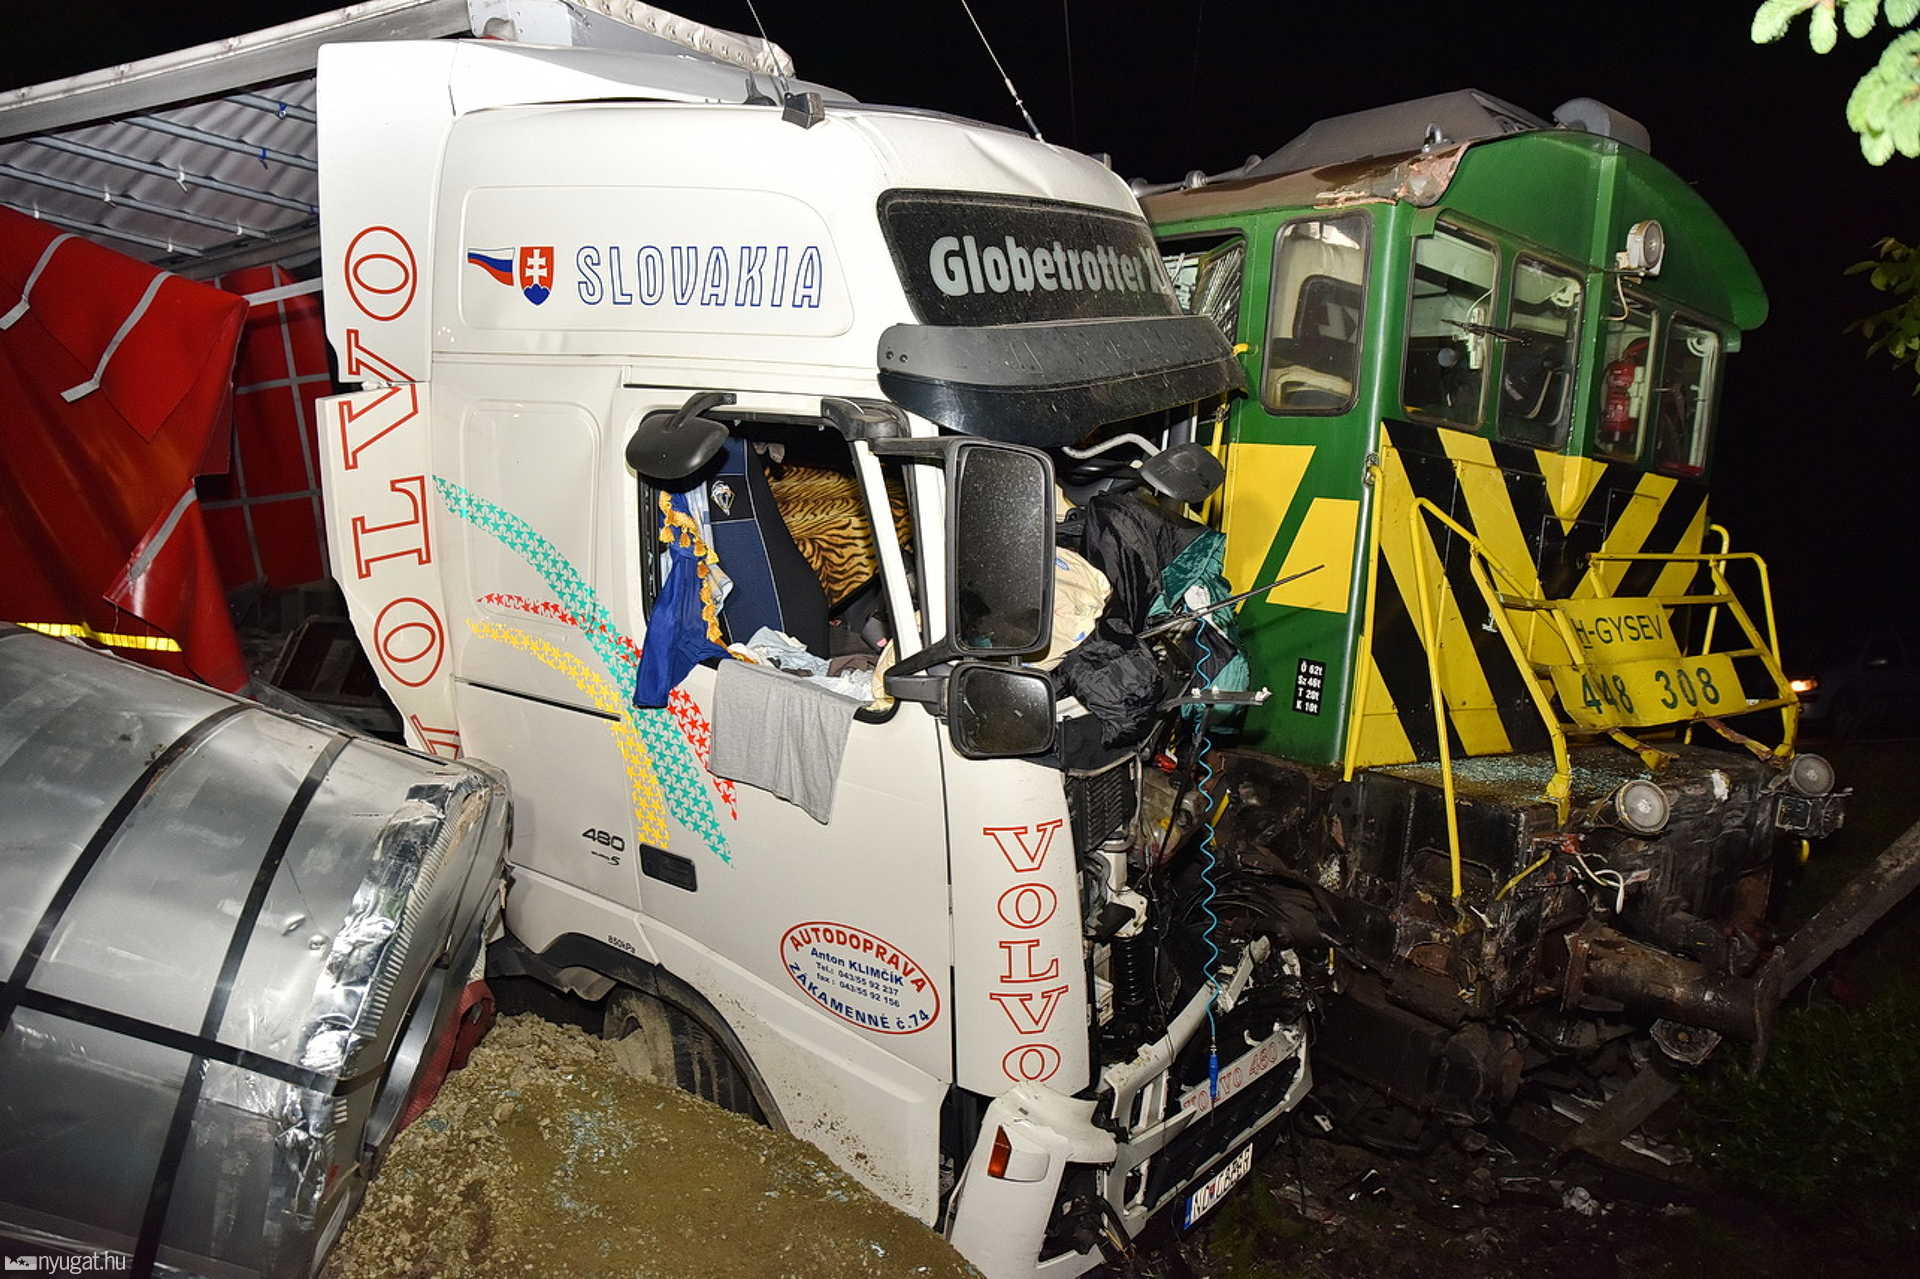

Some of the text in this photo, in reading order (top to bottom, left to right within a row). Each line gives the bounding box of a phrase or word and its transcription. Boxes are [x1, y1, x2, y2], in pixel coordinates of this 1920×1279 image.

[576, 245, 822, 308] SLOVAKIA
[929, 236, 1146, 296] Globetrotter
[1296, 699, 1303, 710] K
[1298, 687, 1304, 697] T
[1582, 667, 1720, 714] 448 308
[582, 828, 625, 852] 480
[789, 927, 927, 992] AUTODOPRAVA
[811, 947, 904, 987] Anton KLIMČÍK
[983, 818, 1069, 1083] VOLVO
[788, 961, 891, 1030] ZÁKAMENNÉ
[868, 980, 880, 990] 92
[869, 991, 881, 1002] 92
